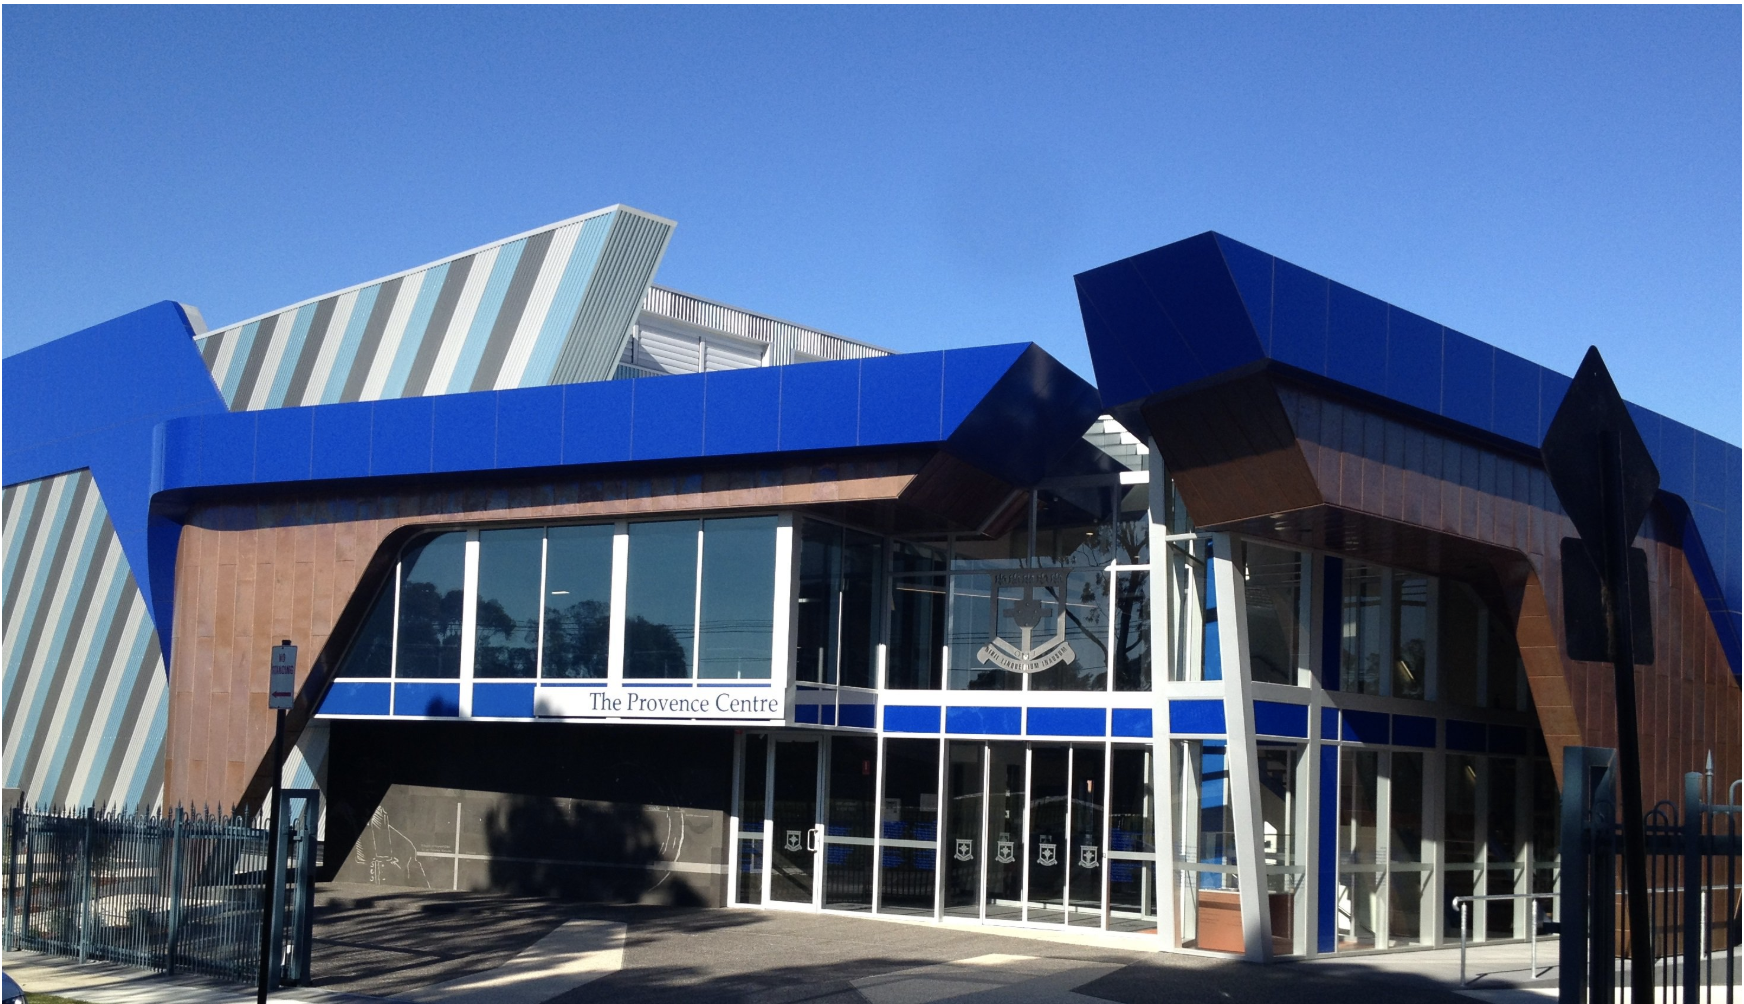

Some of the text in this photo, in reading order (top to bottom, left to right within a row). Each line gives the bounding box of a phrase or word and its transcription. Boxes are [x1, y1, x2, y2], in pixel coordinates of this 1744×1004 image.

[278, 653, 286, 662] NO
[589, 692, 779, 713] The Provence Centre
